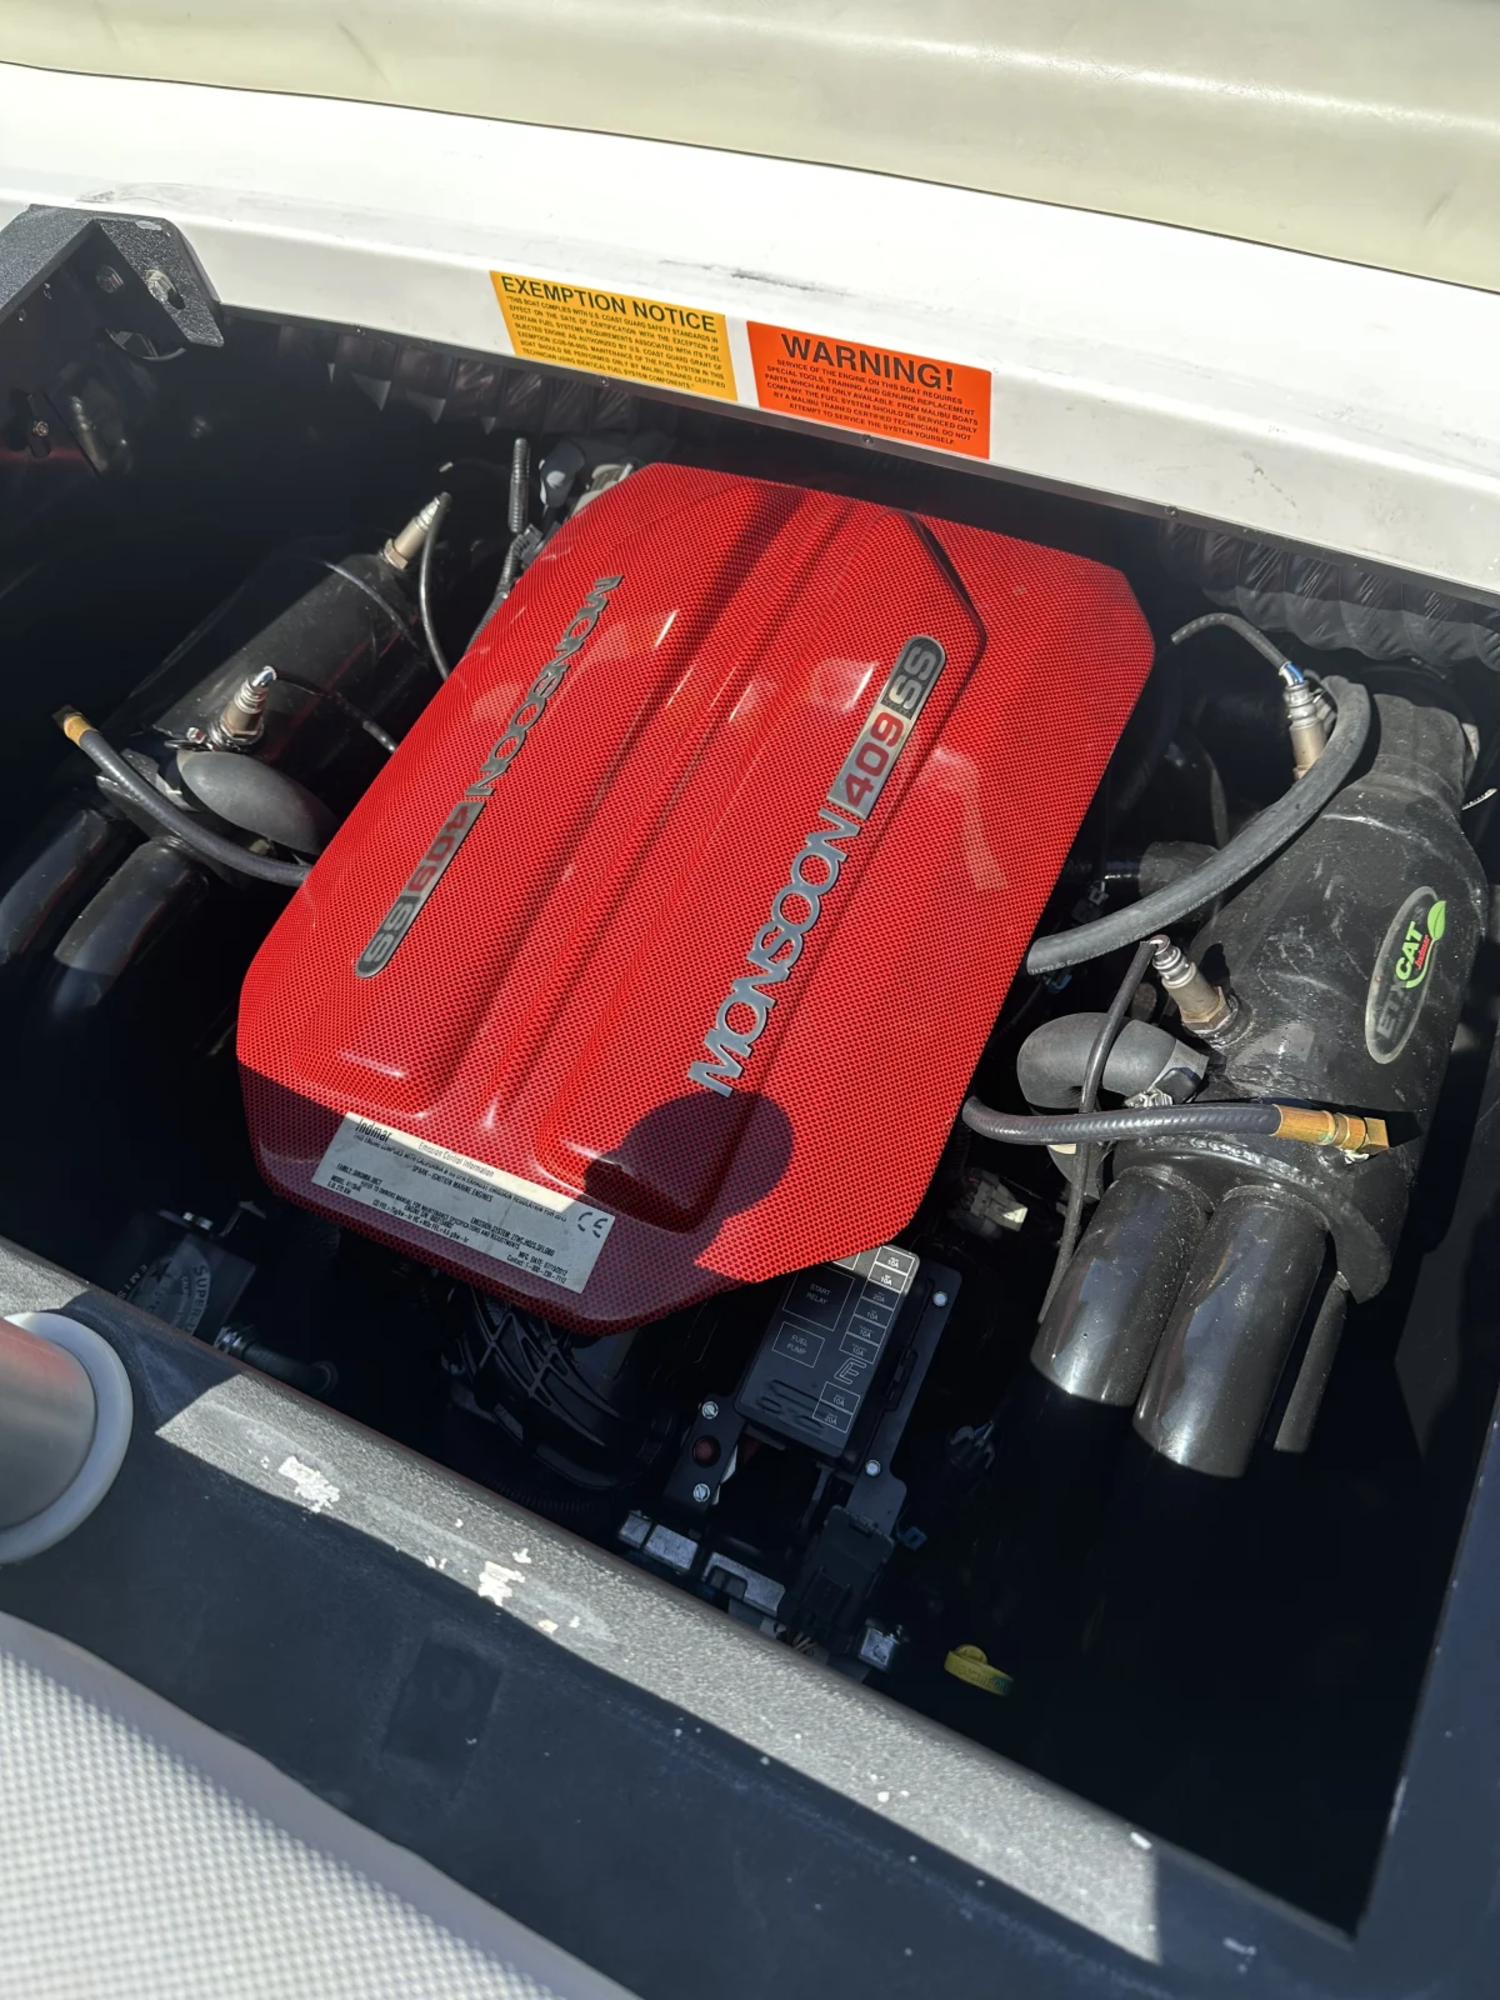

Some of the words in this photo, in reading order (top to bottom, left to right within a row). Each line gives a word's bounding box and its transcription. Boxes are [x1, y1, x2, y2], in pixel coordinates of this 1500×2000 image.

[501, 275, 626, 314] EXEMPTION
[632, 301, 715, 332] NOTICE
[540, 302, 571, 313] COMPLIES
[572, 308, 587, 316] WITH
[601, 314, 621, 323] COAST
[624, 319, 645, 328] GUARD
[647, 323, 671, 333] SAFETY
[672, 328, 709, 341] STANDARDS
[509, 304, 530, 313] EFFECT
[560, 314, 576, 322] DATE
[590, 321, 635, 335] CERTIFICATION
[639, 330, 654, 338] WITH
[673, 337, 707, 349] EXCEPTION
[511, 313, 536, 323] CERTAIN
[635, 338, 673, 351] ASSOCIATED
[675, 346, 690, 354] WITH
[704, 352, 720, 361] FUEL
[590, 346, 632, 359] MAINTENANCE
[658, 360, 673, 368] FUEL
[676, 364, 699, 374] SYSTEM
[643, 349, 663, 358] COAST
[665, 353, 687, 363] GUARD
[690, 358, 710, 367] GRANT
[781, 333, 952, 392] WARNING!
[764, 373, 788, 383] PARTS
[790, 378, 814, 389] WHICH
[815, 384, 830, 392] ARE
[832, 388, 850, 397] ONLY
[897, 402, 918, 412] FROM
[921, 407, 949, 419] MALIBU
[952, 414, 977, 425] BOATS
[767, 365, 796, 376] SPECIAL
[828, 378, 861, 390] TRAINING
[864, 386, 879, 394] AND
[881, 390, 914, 402] GENUINE
[917, 398, 974, 415] REPLACEMENT
[777, 359, 807, 370] SERVICE
[822, 368, 835, 376] THE
[838, 372, 865, 383] ENGINE
[868, 378, 879, 386] ON
[882, 381, 897, 390] THIS
[900, 385, 919, 394] BOAT
[922, 390, 961, 404] REQUIRES
[789, 402, 820, 414] ATTEMPT
[834, 413, 863, 424] SERVICE
[867, 420, 880, 428] THE
[883, 424, 912, 435] SYSTEM
[805, 390, 818, 398] THE
[821, 393, 839, 403] FUEL
[841, 398, 870, 409] SYSTEM
[872, 405, 902, 417] SHOULD
[917, 415, 954, 428] SERVICED
[957, 424, 977, 433] ONLY
[821, 401, 851, 413] TRAINED
[853, 409, 891, 422] CERTIFIED
[956, 432, 970, 440] NOT
[465, 575, 624, 796] MONSOON
[406, 804, 469, 892] 409
[686, 809, 860, 1098] MONSOON
[845, 712, 903, 810] 409
[888, 646, 937, 709] SS
[364, 900, 414, 963] SS
[1396, 921, 1422, 980] CAT
[806, 1292, 828, 1305] RELAY
[810, 1284, 831, 1296] START
[787, 1344, 806, 1355] PUMP
[791, 1335, 808, 1346] FUEL
